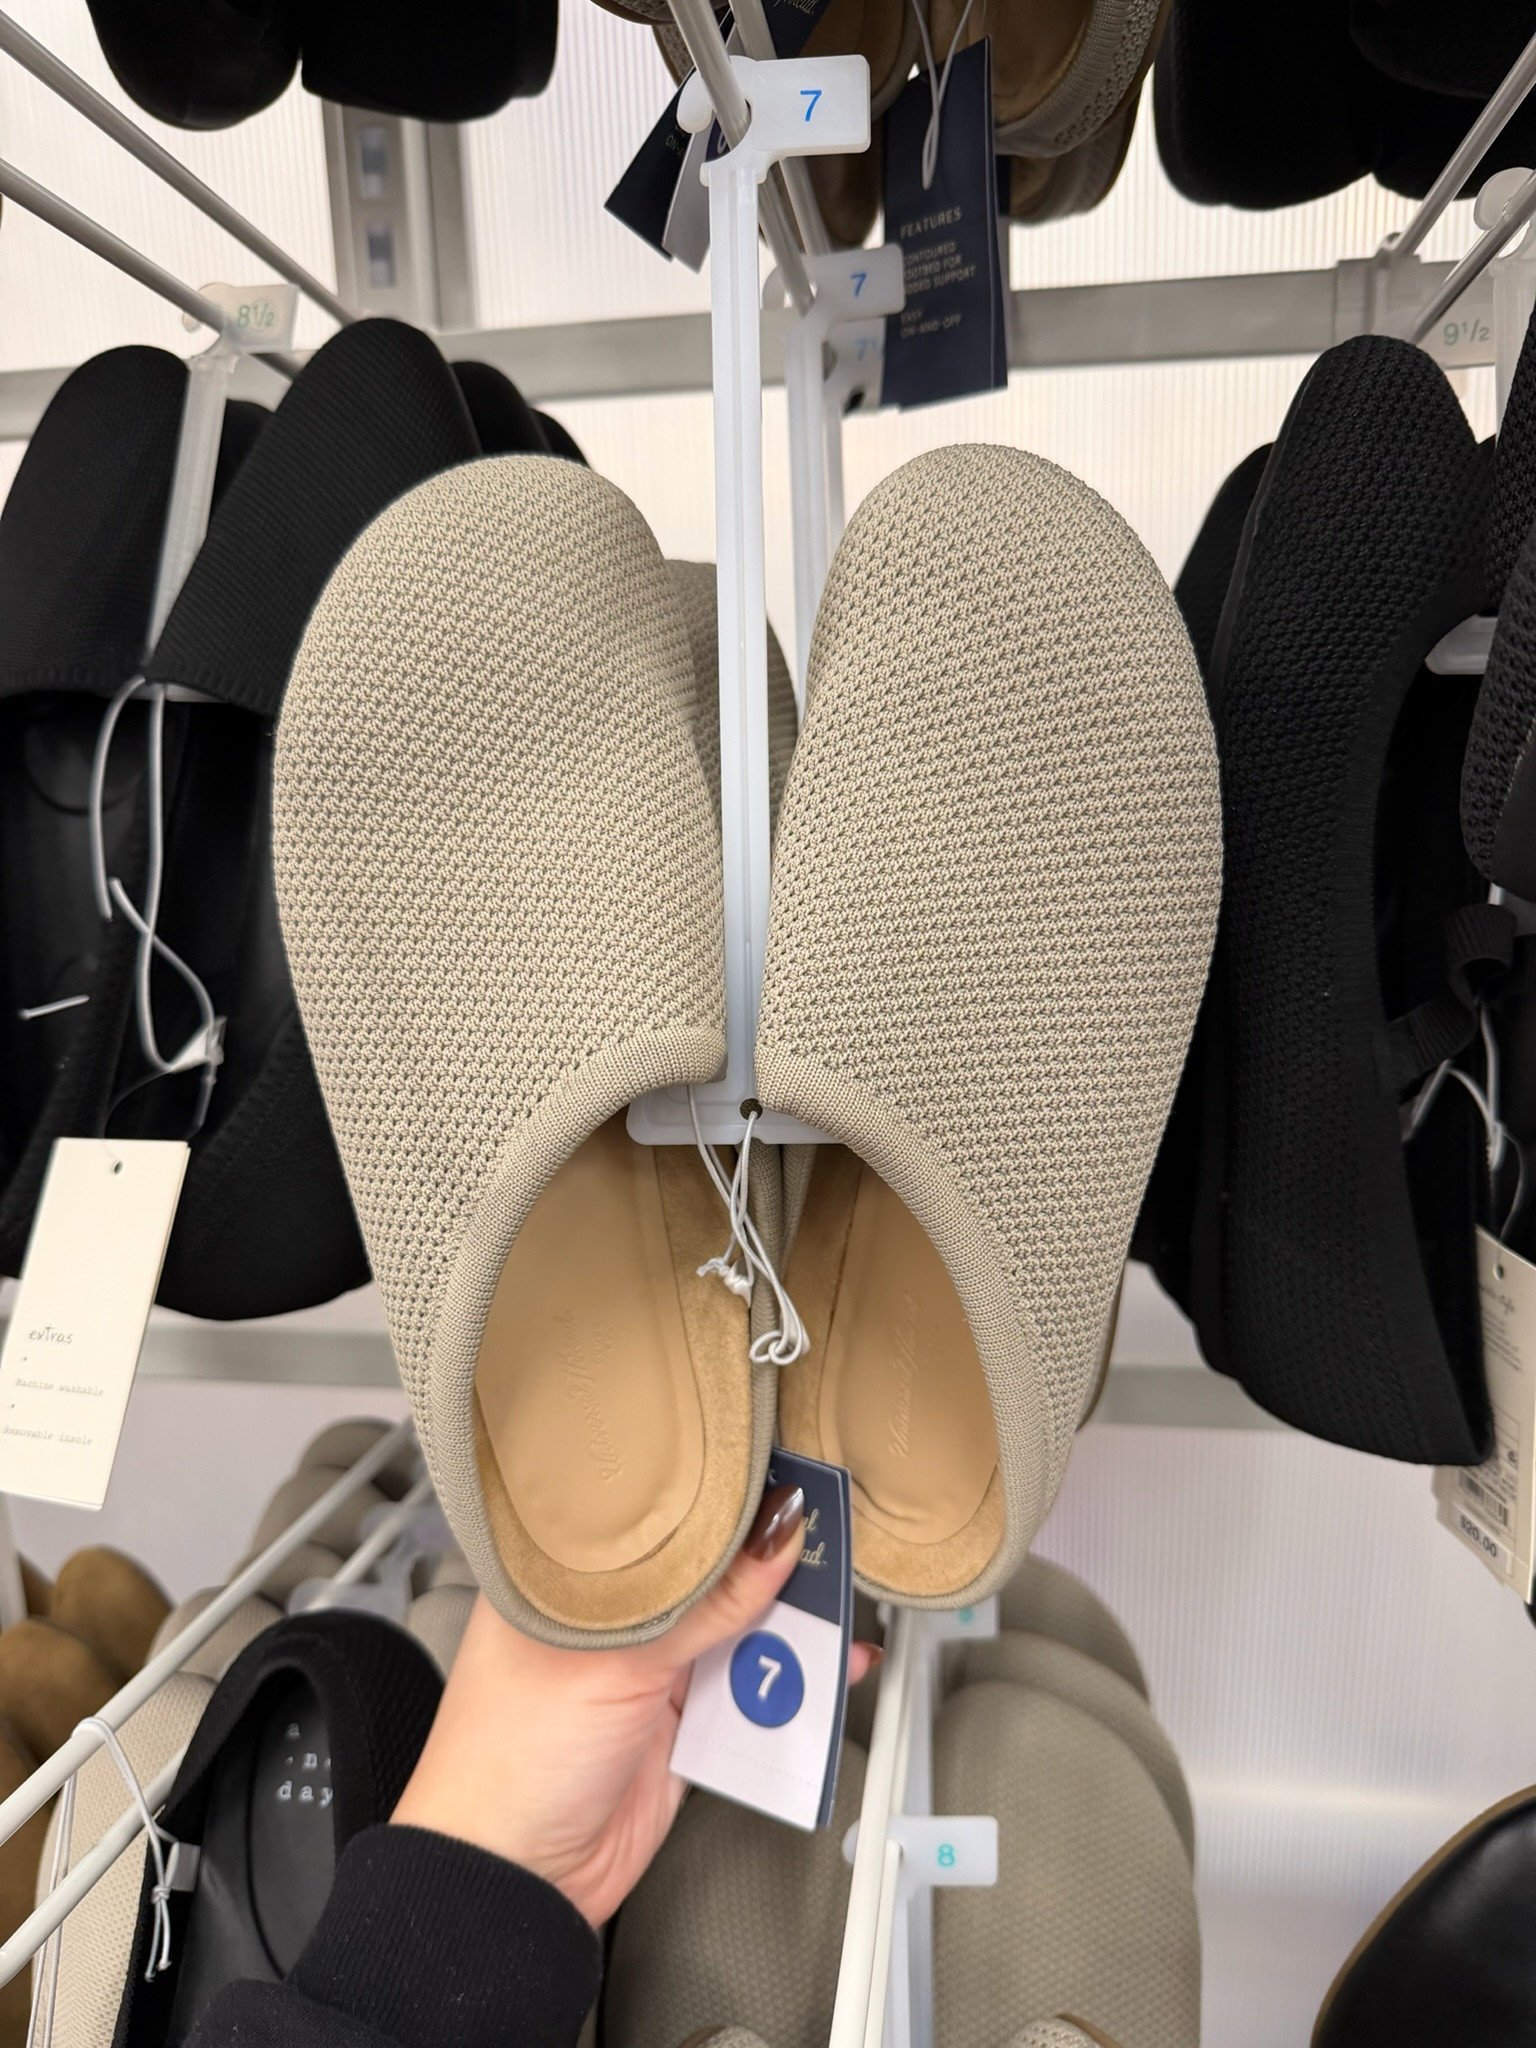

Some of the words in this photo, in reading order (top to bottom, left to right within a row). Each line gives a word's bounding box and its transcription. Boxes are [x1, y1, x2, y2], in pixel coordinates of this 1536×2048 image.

[799, 89, 823, 122] 7
[901, 206, 962, 238] FEATURES
[849, 272, 868, 297] 7
[29, 1324, 73, 1344] extras
[16, 1378, 54, 1391] Machine
[59, 1384, 104, 1397] washable
[4, 1424, 54, 1440] Removable
[59, 1432, 93, 1445] insole
[1460, 1515, 1498, 1558] $20.00
[757, 1654, 783, 1701] 7
[287, 1723, 300, 1738] a
[277, 1780, 334, 1808] day
[937, 1843, 956, 1868] 8
